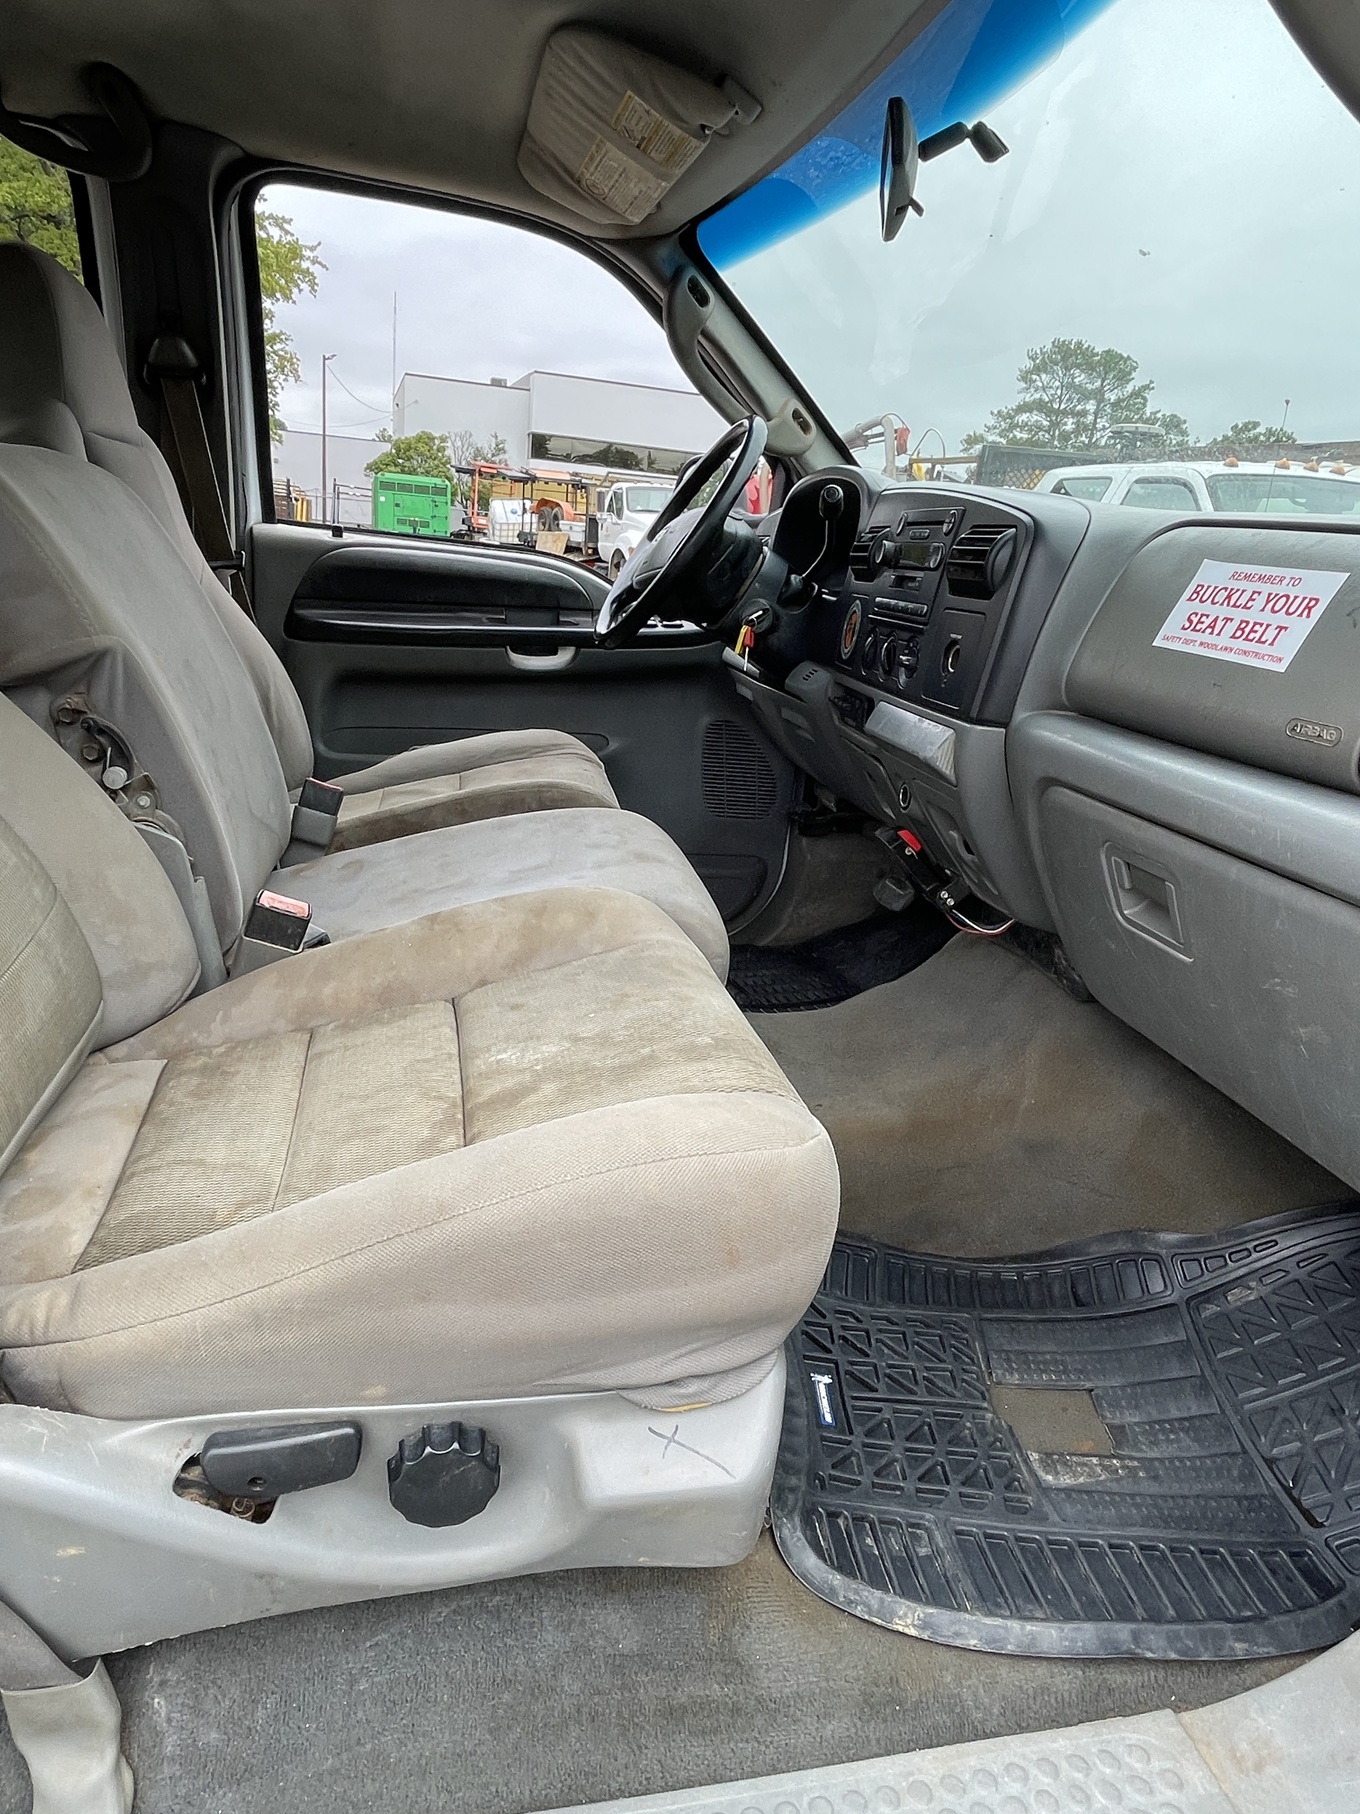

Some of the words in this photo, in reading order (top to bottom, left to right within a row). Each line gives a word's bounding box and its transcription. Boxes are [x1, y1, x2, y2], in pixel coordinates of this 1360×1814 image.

[1229, 571, 1286, 585] REMEMBER
[1287, 576, 1302, 587] TO
[1186, 584, 1261, 610] BUCKLE
[1260, 592, 1320, 619] YOUR
[1181, 612, 1235, 637] SEAT
[1229, 619, 1290, 646] BELT
[1162, 635, 1182, 644] SAFETY
[1198, 641, 1234, 653] WOODLAWN
[1234, 647, 1284, 663] CONSTRUCTION
[1292, 723, 1336, 740] AIRBAG
